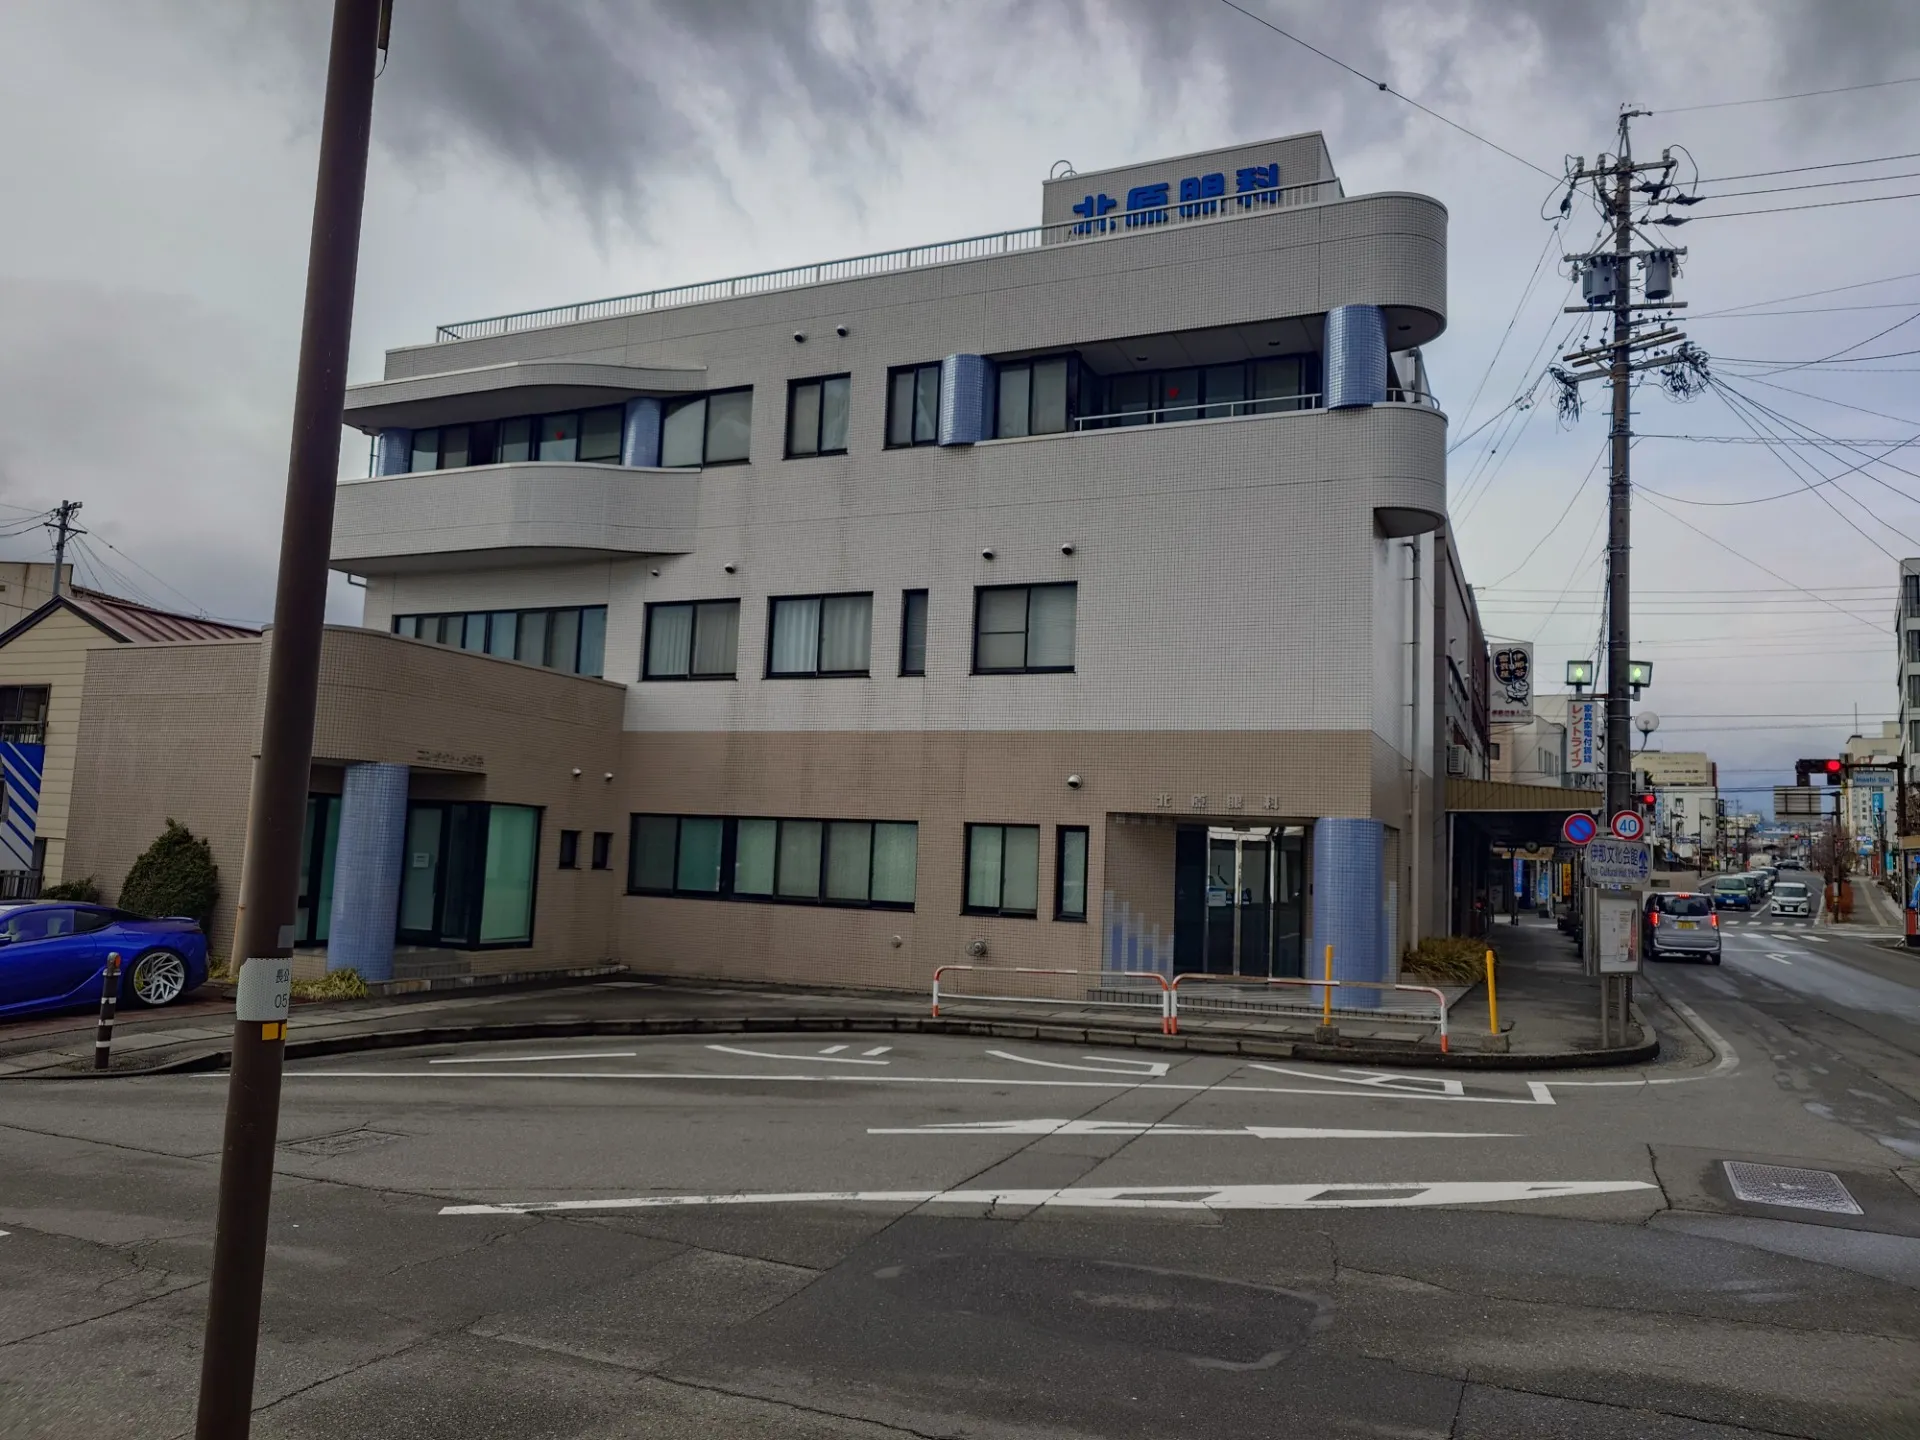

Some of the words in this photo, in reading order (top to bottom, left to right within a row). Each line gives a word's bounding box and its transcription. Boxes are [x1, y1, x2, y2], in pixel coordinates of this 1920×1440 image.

[1072, 162, 1280, 234] 北原眼科
[1571, 704, 1583, 769] レントライフ
[1157, 792, 1280, 810] 北原眼科
[1619, 819, 1637, 833] 40
[1591, 844, 1638, 866] 伊那文化会館
